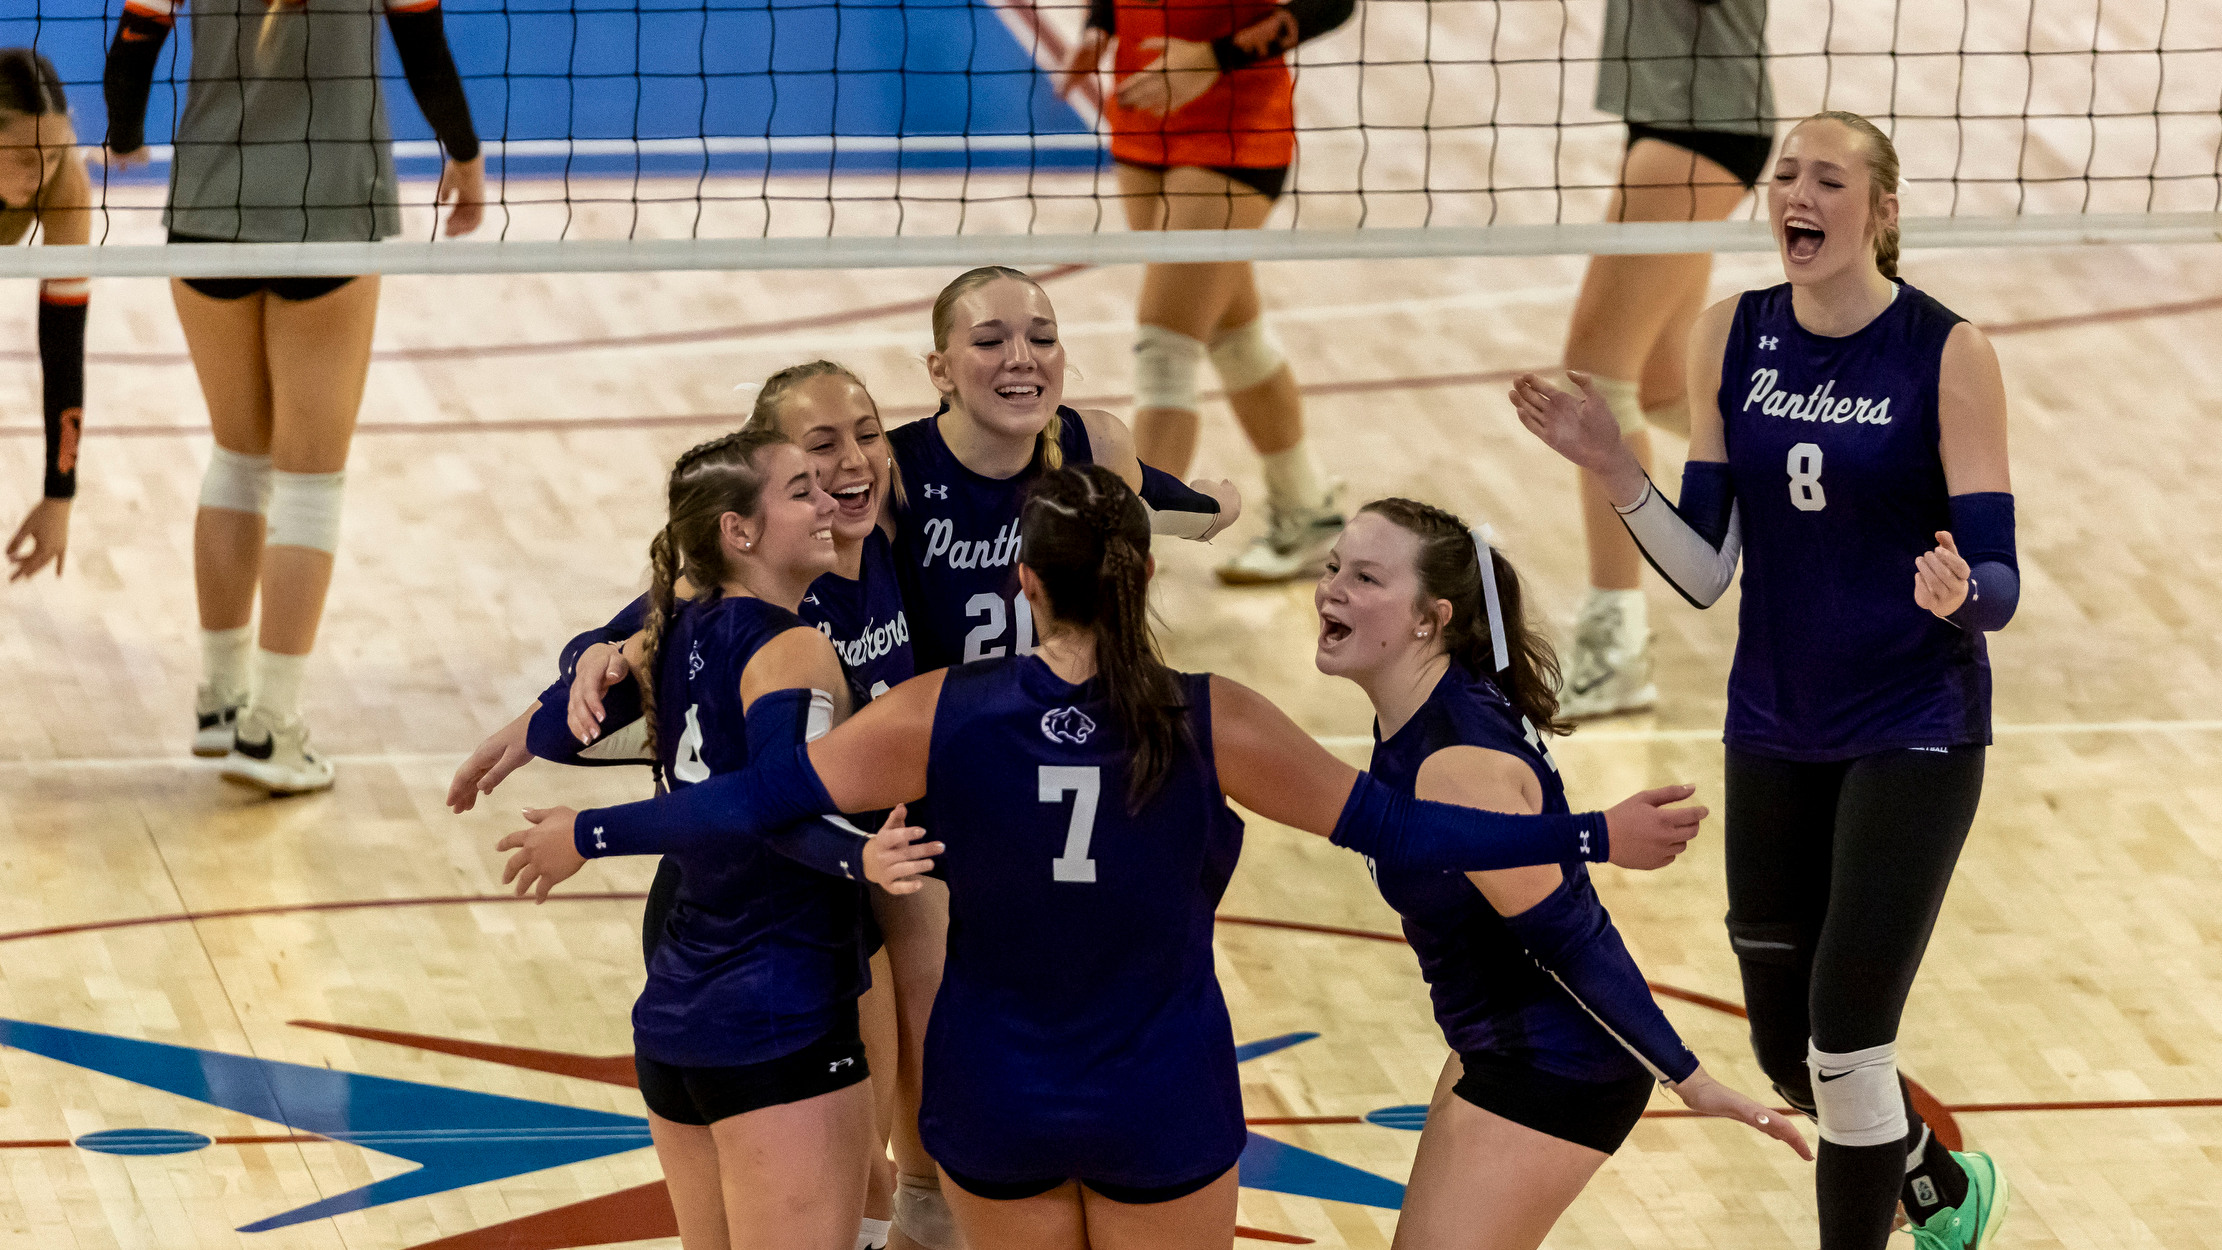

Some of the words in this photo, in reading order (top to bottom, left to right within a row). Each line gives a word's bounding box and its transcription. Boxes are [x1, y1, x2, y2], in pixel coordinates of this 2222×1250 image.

[1742, 367, 1893, 426] Panthers
[1786, 442, 1828, 512] 8
[922, 517, 1023, 570] Panth
[1038, 765, 1100, 883] 7
